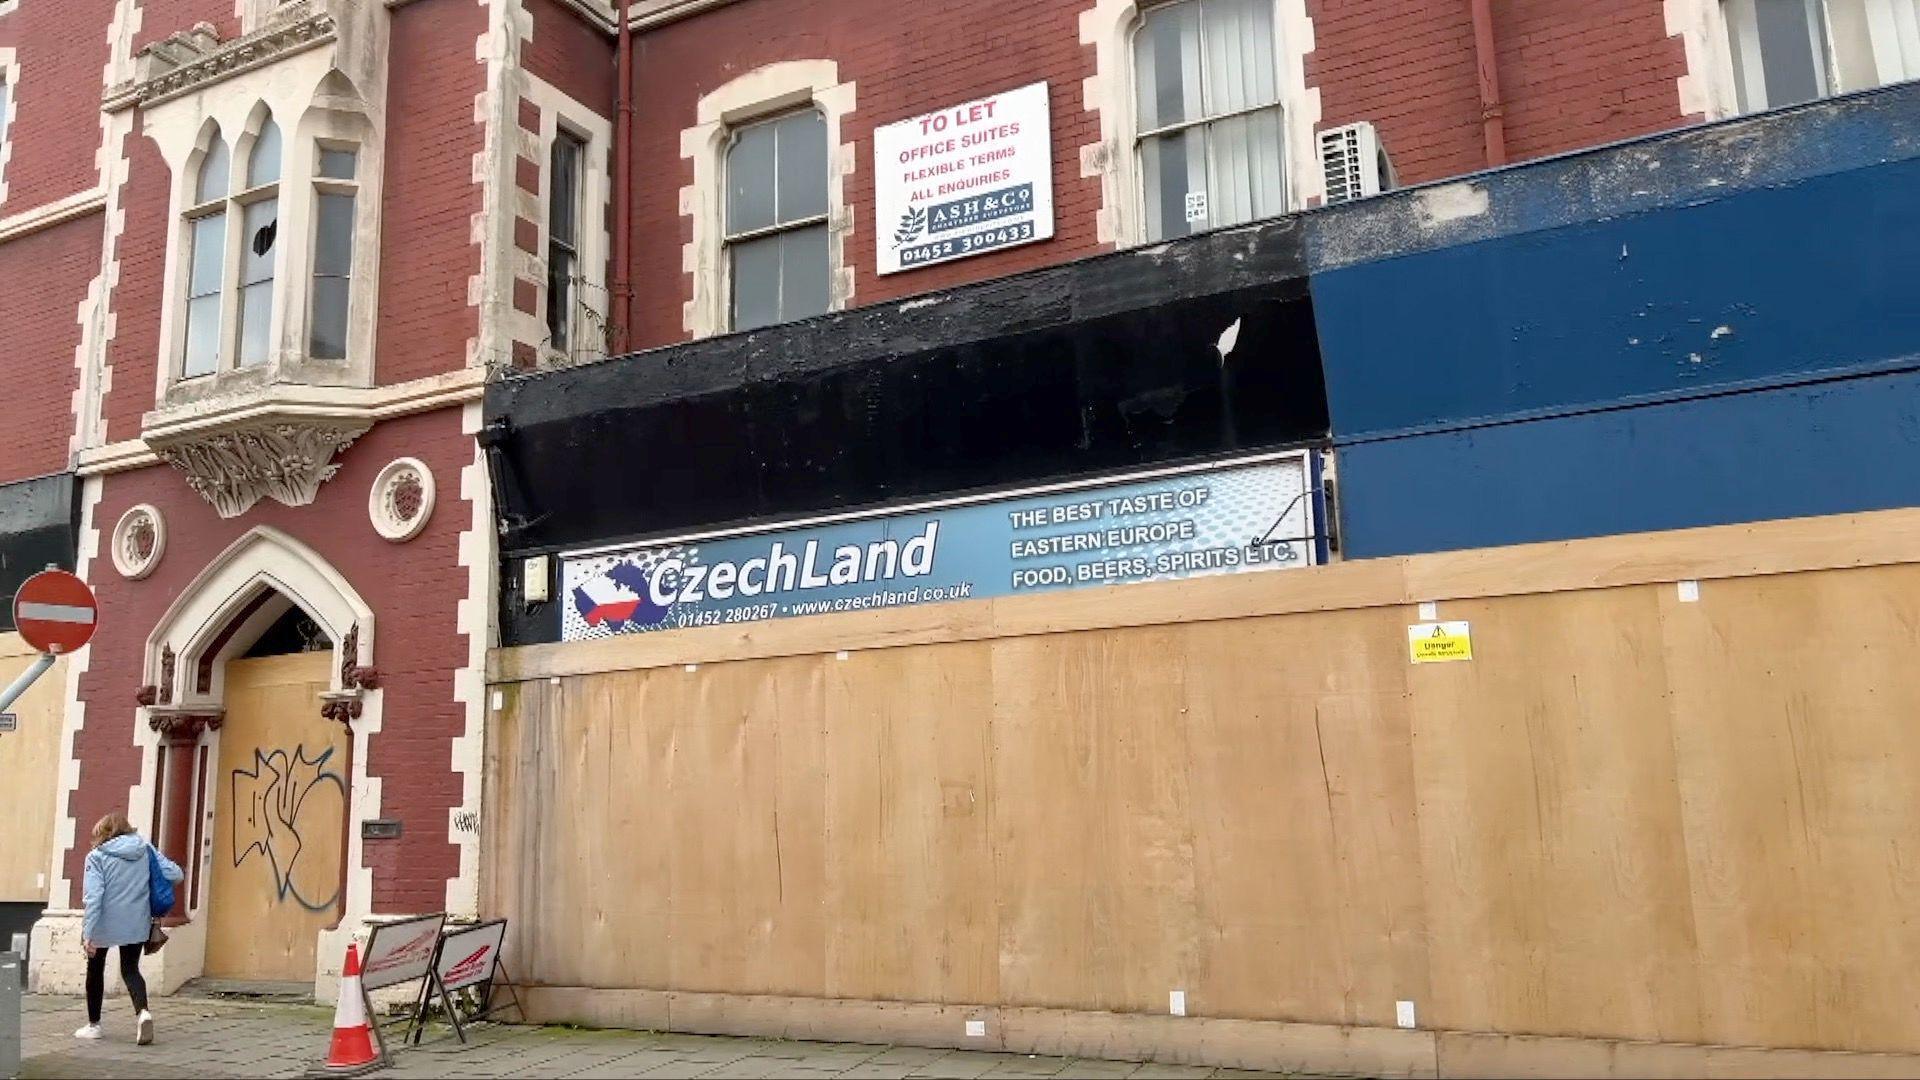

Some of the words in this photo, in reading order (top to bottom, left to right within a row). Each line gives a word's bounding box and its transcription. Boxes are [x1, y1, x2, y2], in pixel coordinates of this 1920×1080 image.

[919, 115, 948, 136] TO
[956, 101, 997, 126] LET
[899, 139, 955, 164] OFFICE
[961, 122, 1020, 148] SUITES
[904, 159, 965, 184] FLEXIBLE
[969, 147, 1016, 167] TERMS
[910, 188, 933, 202] ALL
[938, 169, 1010, 195] ENQUIRIES
[903, 241, 953, 261] 01452
[962, 224, 1031, 250] 300433
[1010, 508, 1047, 528] THE
[1052, 502, 1102, 522] BEST
[1108, 494, 1174, 516] TASTE
[1179, 487, 1209, 507] OF
[1011, 531, 1101, 558] EASTERN
[1108, 520, 1194, 547] EUROPE
[648, 520, 940, 607] CzechLand
[1013, 567, 1073, 588] FOOD,
[1077, 557, 1151, 578] BEERS,
[1157, 546, 1238, 573] SPIRITS
[1245, 542, 1296, 564] ETC.
[678, 610, 721, 628] 01452
[725, 603, 777, 622] 280267
[792, 581, 972, 615] www.czechland.co.uk
